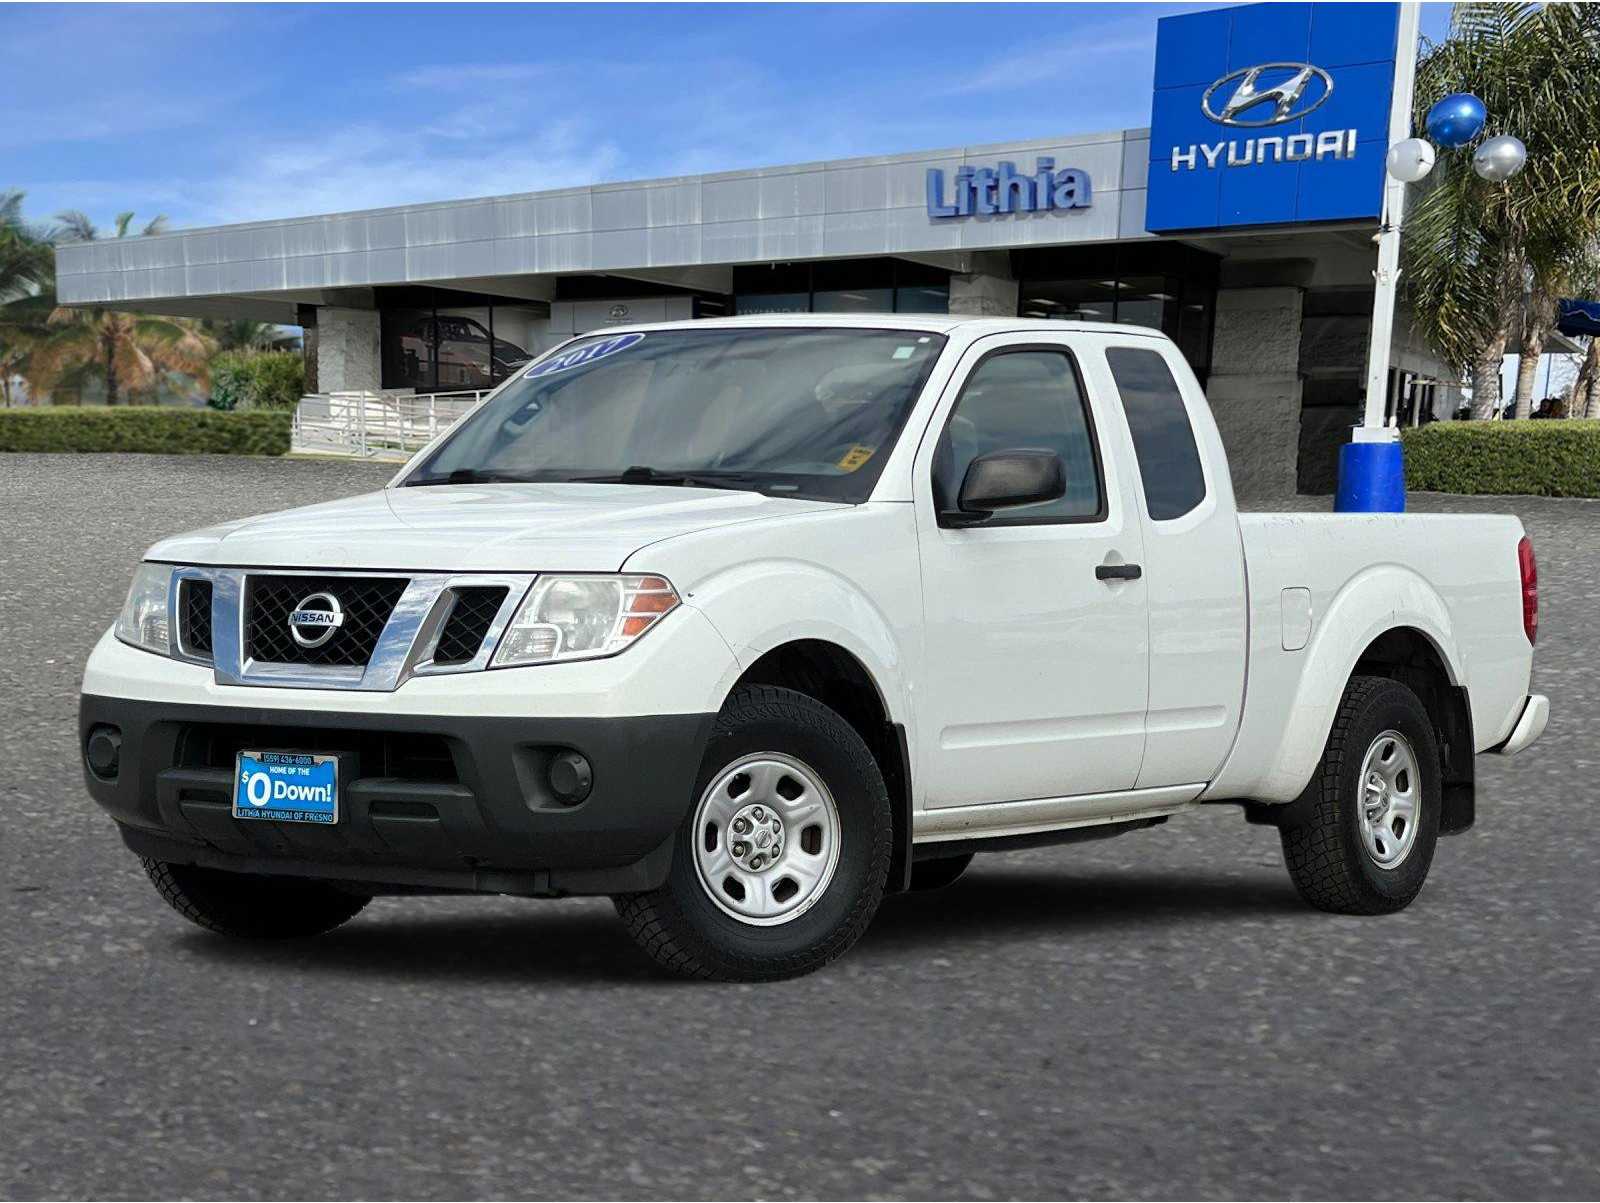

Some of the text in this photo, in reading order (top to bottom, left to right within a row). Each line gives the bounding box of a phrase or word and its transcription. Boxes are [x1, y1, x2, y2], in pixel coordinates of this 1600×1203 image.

[1171, 129, 1357, 171] HYUNDAI
[925, 156, 1093, 219] Lithia
[291, 613, 335, 624] NISSAN
[269, 766, 310, 776] HOME OF THE
[273, 780, 332, 802] Down!
[237, 808, 333, 822] LITHIA HYUNDAI OF FRESNO
